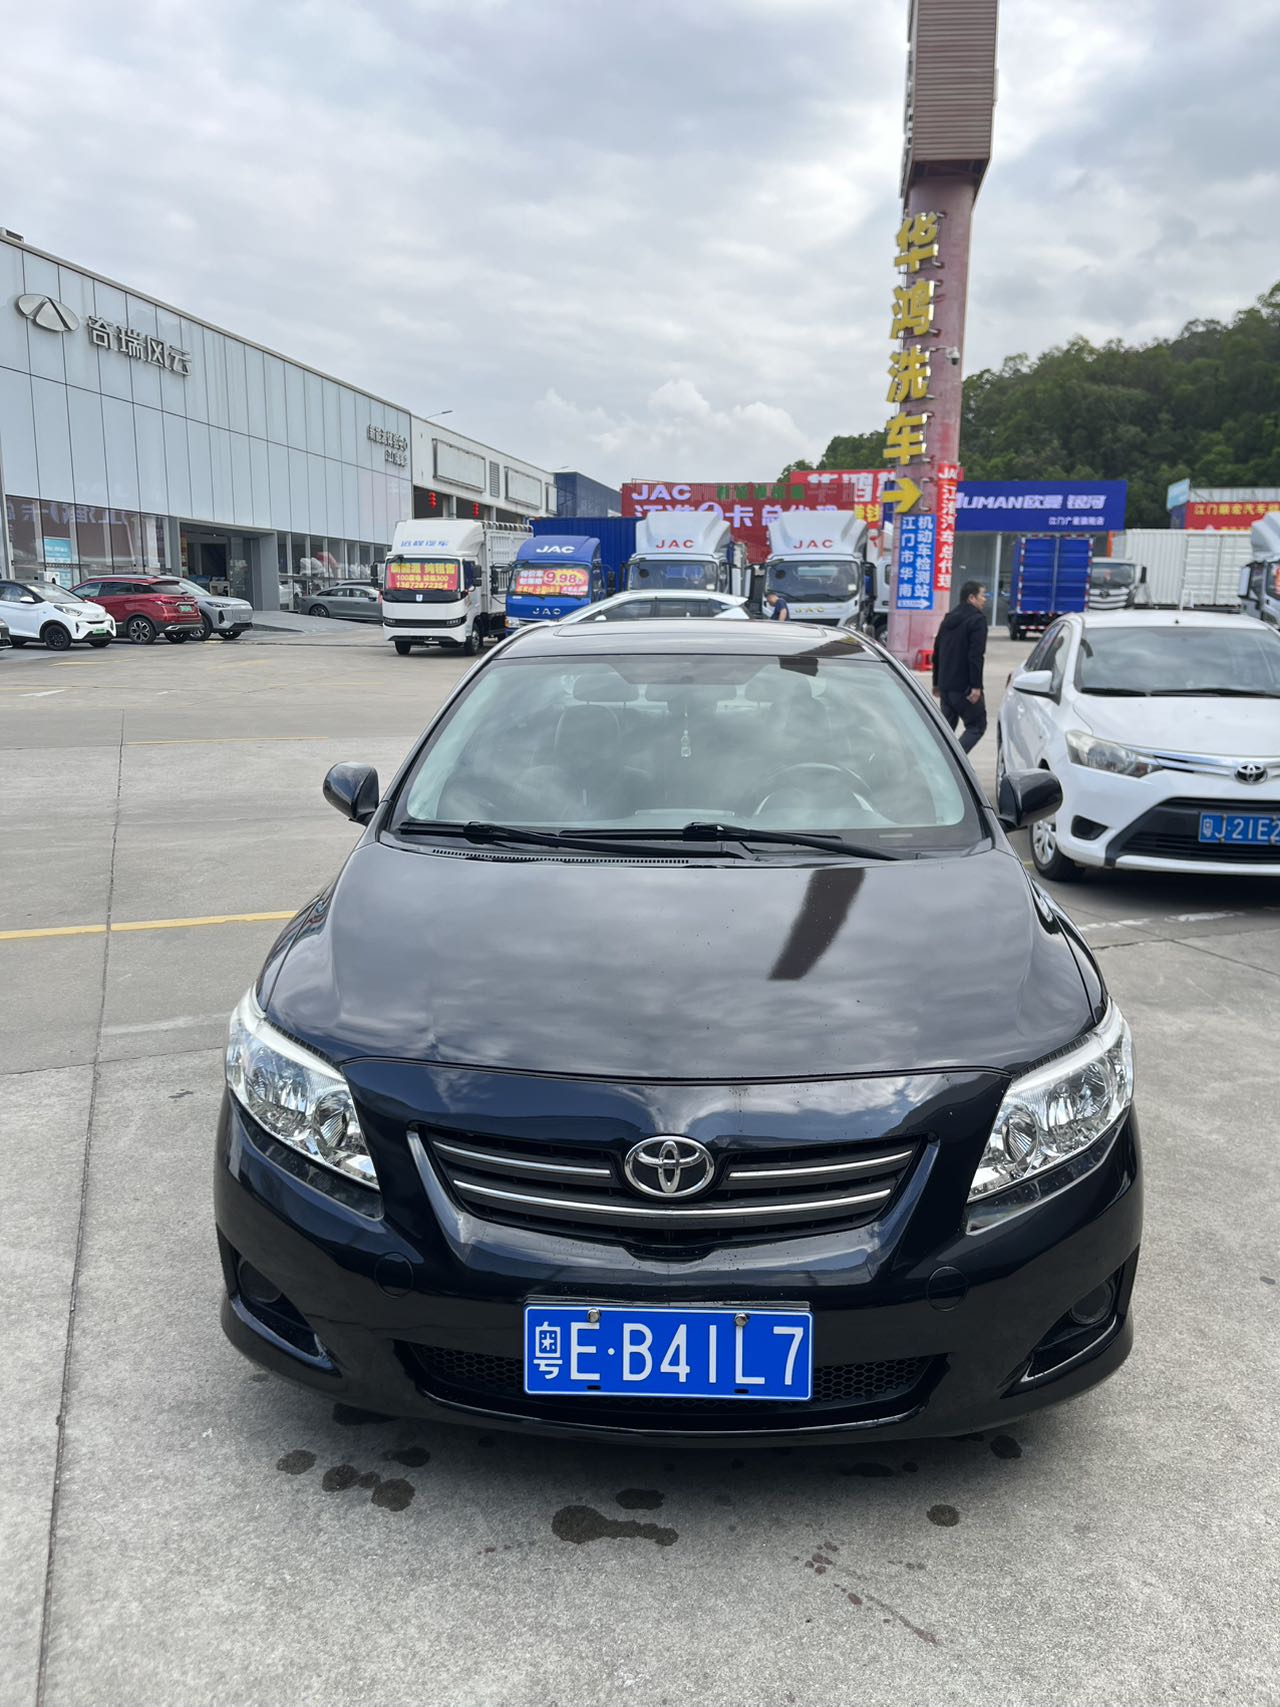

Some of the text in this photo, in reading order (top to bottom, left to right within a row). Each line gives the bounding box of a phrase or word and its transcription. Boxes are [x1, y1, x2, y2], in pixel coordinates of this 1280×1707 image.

[87, 315, 192, 376] 奇瑞风云
[883, 211, 939, 466] 华鸿洗车
[631, 484, 692, 500] JAC
[938, 467, 959, 480] JA
[536, 545, 575, 554] JAC
[656, 540, 694, 549] JAC
[793, 540, 833, 549] JAC
[899, 516, 916, 597] 江门市华南
[914, 516, 933, 597] 机动车检测站
[937, 484, 957, 588] 江淮汽车总代理
[533, 1321, 804, 1386] 粤E·B41L7
